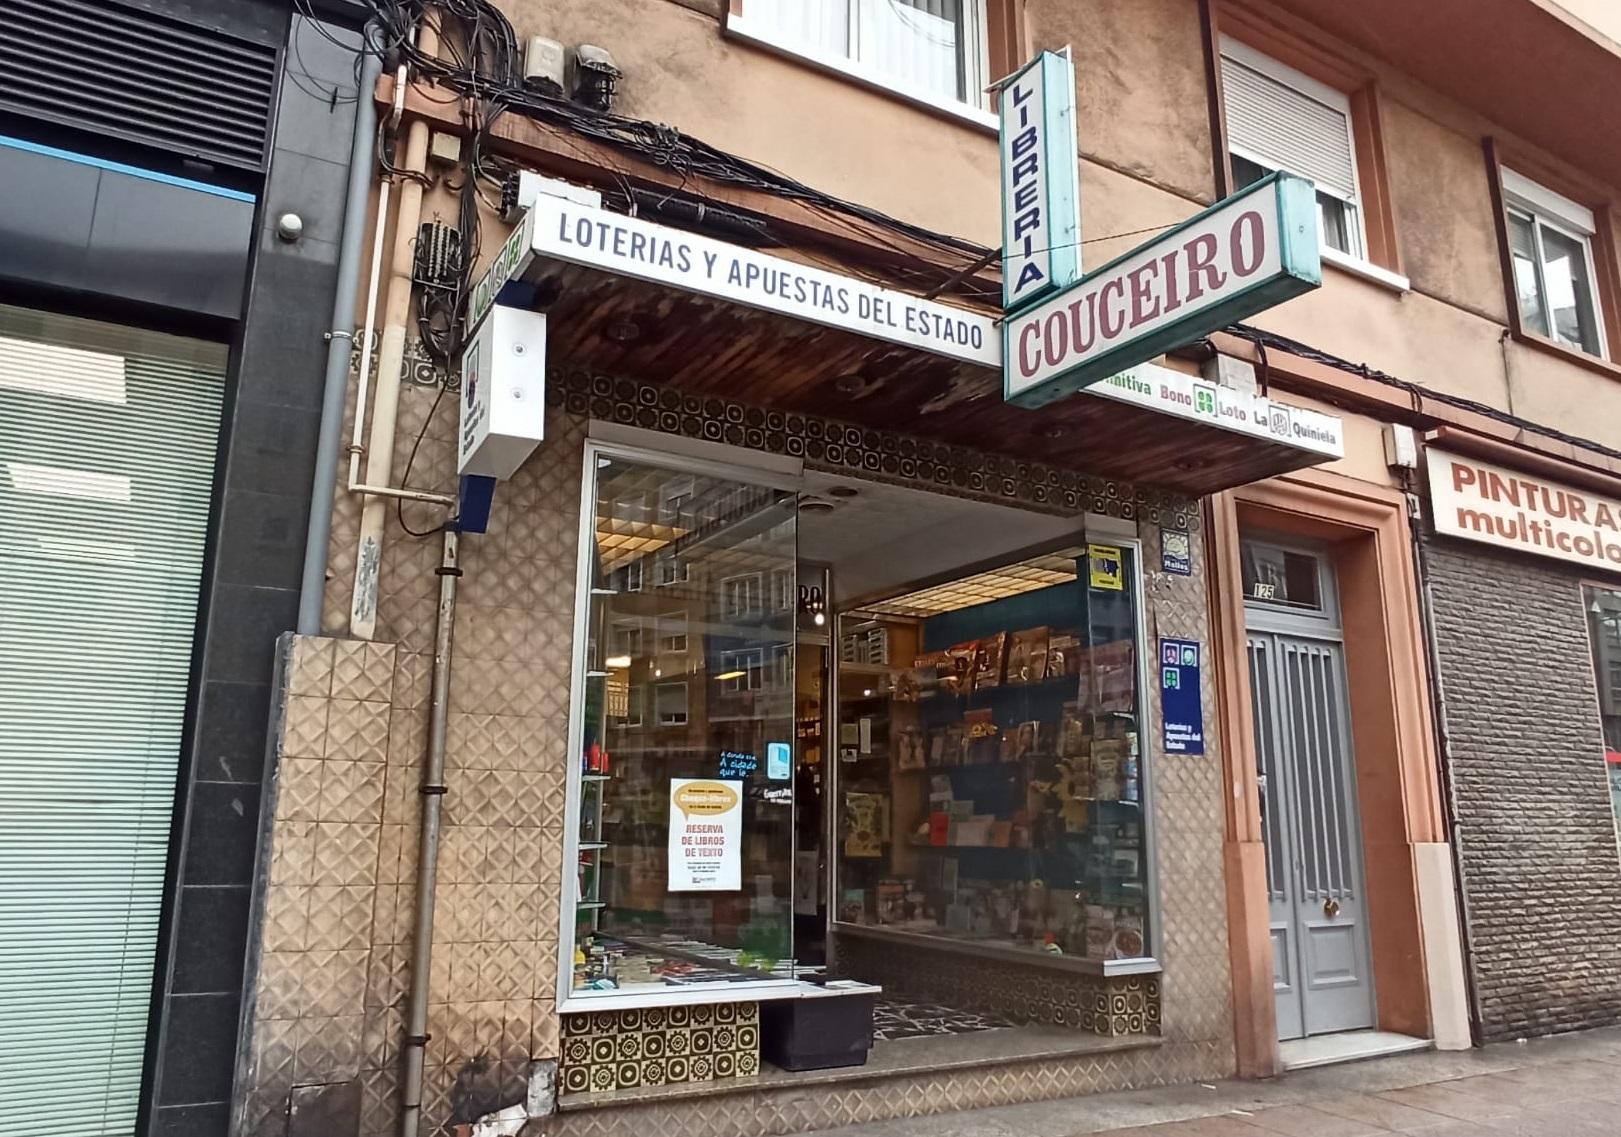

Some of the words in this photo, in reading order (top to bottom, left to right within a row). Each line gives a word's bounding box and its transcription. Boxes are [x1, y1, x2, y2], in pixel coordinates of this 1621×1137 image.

[1011, 84, 1045, 296] LIBRERIA
[558, 211, 693, 273] LOTERIAS
[702, 249, 718, 277] Y
[727, 258, 850, 314] APUESTAS
[857, 293, 898, 328] DEL
[904, 308, 983, 351] ESTADO
[1018, 209, 1266, 378] COUCEIRO
[1159, 384, 1192, 406] Bono
[1218, 402, 1247, 421] Loto
[1253, 410, 1268, 428] La
[1292, 421, 1337, 445] Quiniela
[1451, 461, 1621, 534] PINTURA
[1255, 584, 1273, 599] 125
[681, 836, 693, 846] DE
[695, 836, 725, 846] LIBROS
[685, 847, 697, 858] DE
[698, 847, 723, 858] TEXTO
[686, 824, 724, 834] RESERVA
